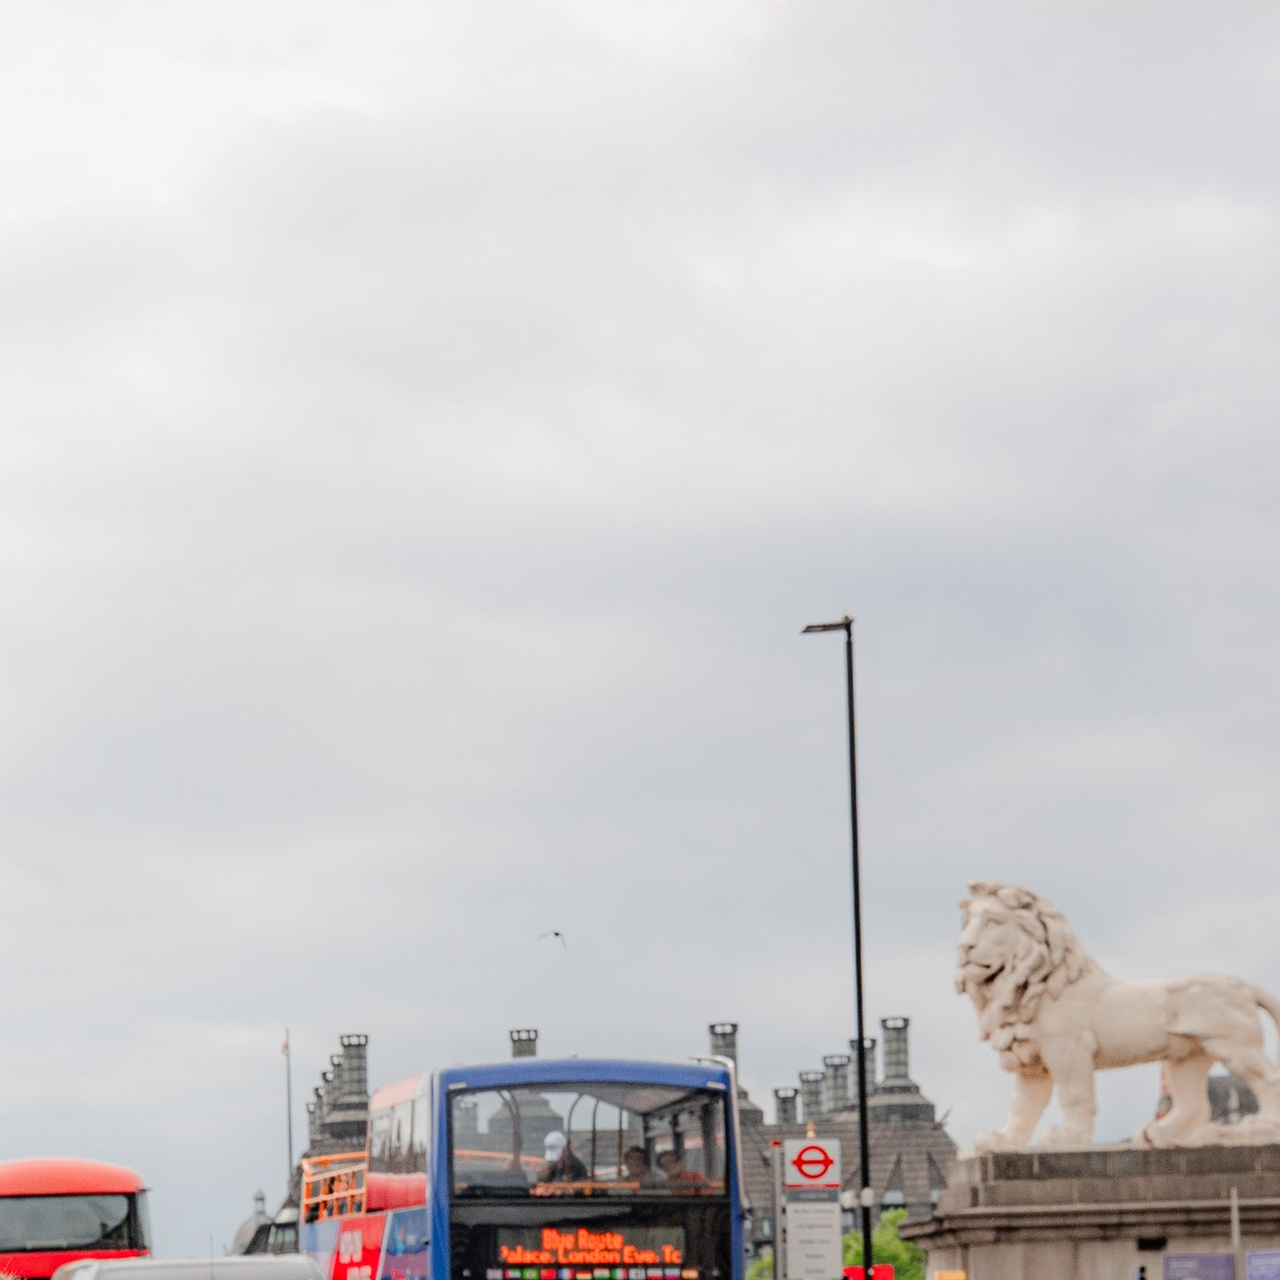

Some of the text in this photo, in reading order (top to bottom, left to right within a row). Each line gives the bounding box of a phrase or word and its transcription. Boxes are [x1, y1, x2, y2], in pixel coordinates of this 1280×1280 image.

[541, 1227, 623, 1250] Blue Route
[557, 1245, 620, 1264] London
